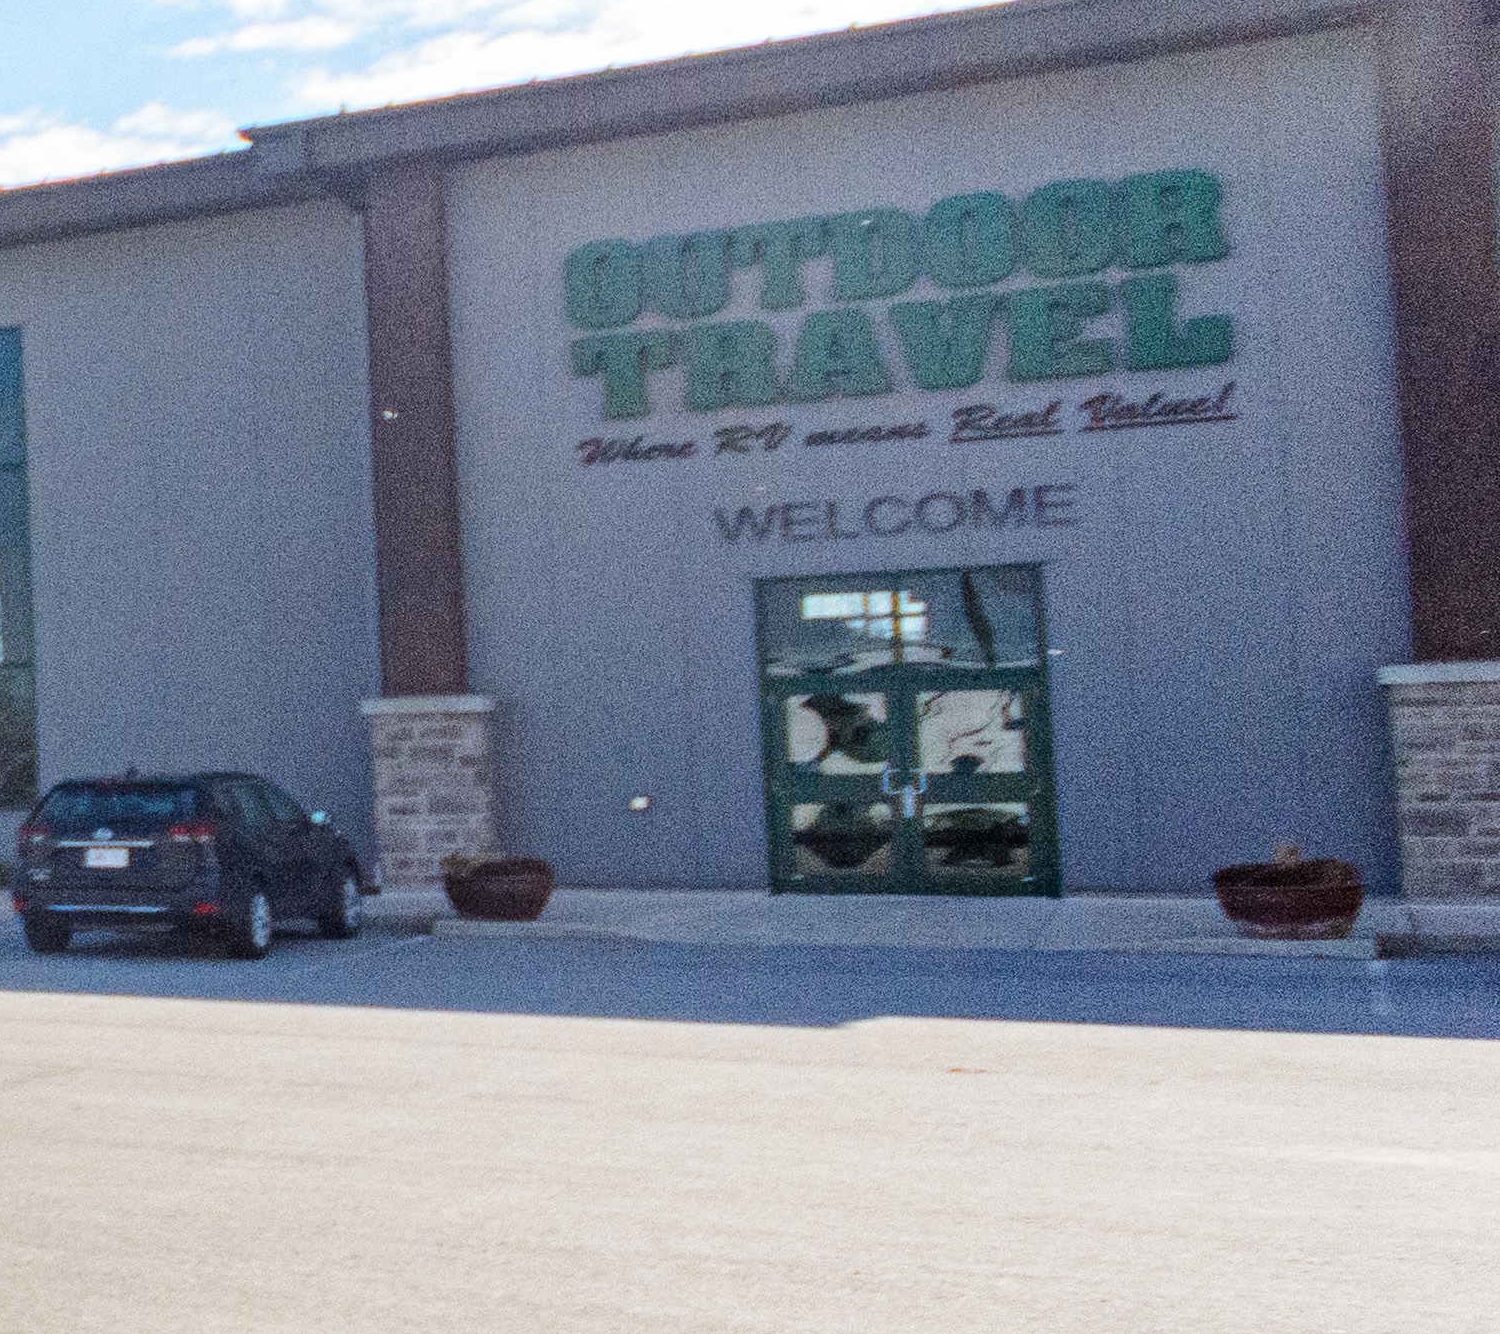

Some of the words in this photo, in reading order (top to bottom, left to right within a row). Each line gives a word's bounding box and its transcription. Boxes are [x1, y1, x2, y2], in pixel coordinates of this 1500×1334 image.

[564, 168, 1233, 329] OUTDOOR
[572, 272, 1234, 420] TRAVEL
[576, 436, 696, 465] Where
[713, 422, 791, 457] RV
[804, 422, 929, 447] means
[949, 401, 1062, 440] Real
[1080, 382, 1236, 430] Value!
[712, 482, 1080, 544] WELCOME
